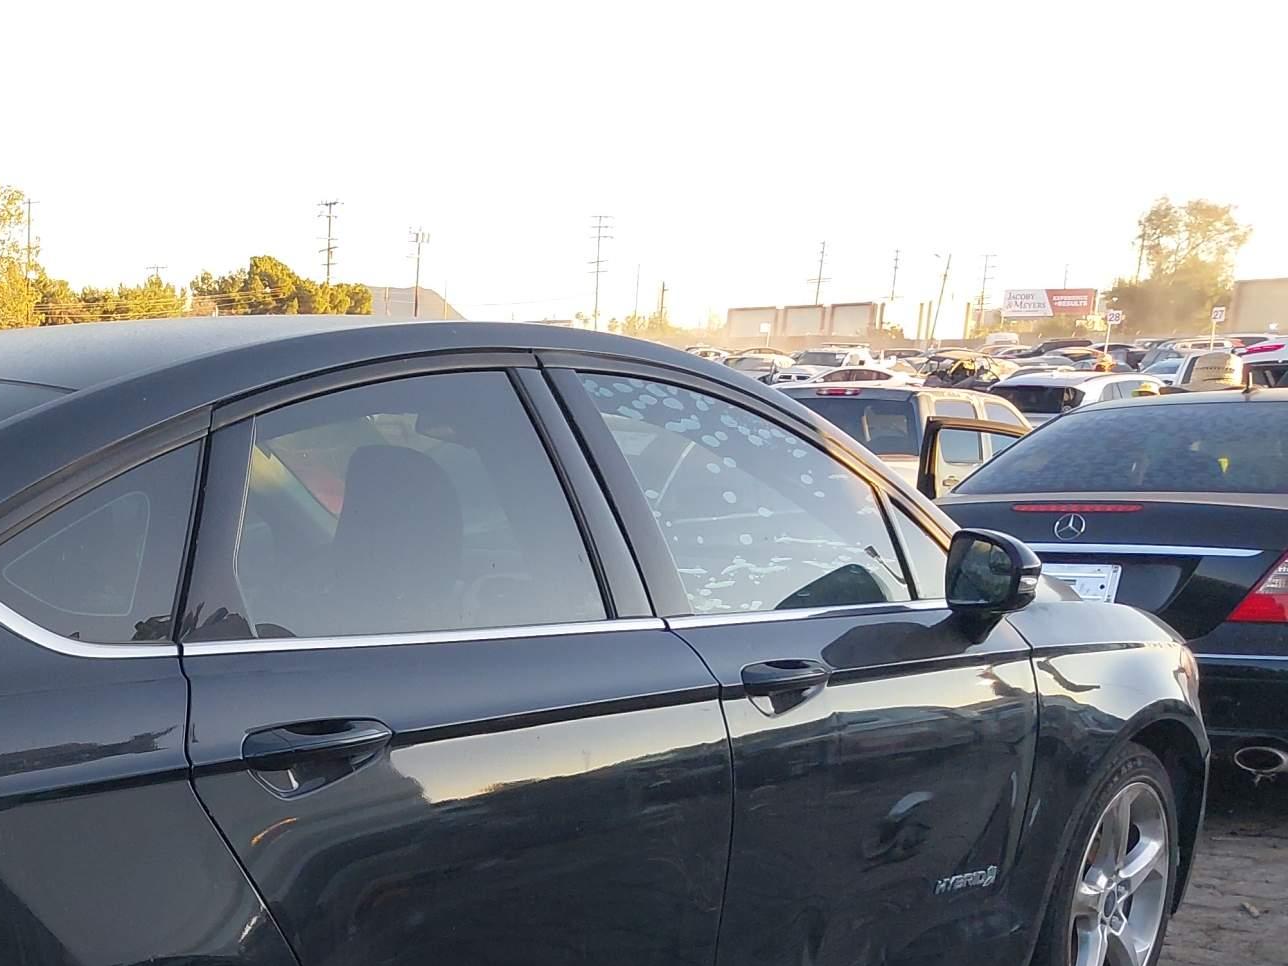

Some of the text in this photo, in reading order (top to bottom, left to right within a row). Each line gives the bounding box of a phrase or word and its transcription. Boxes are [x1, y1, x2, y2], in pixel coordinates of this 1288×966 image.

[1108, 313, 1121, 322] 28
[1212, 310, 1225, 320] 27
[934, 870, 987, 895] HYBRID
